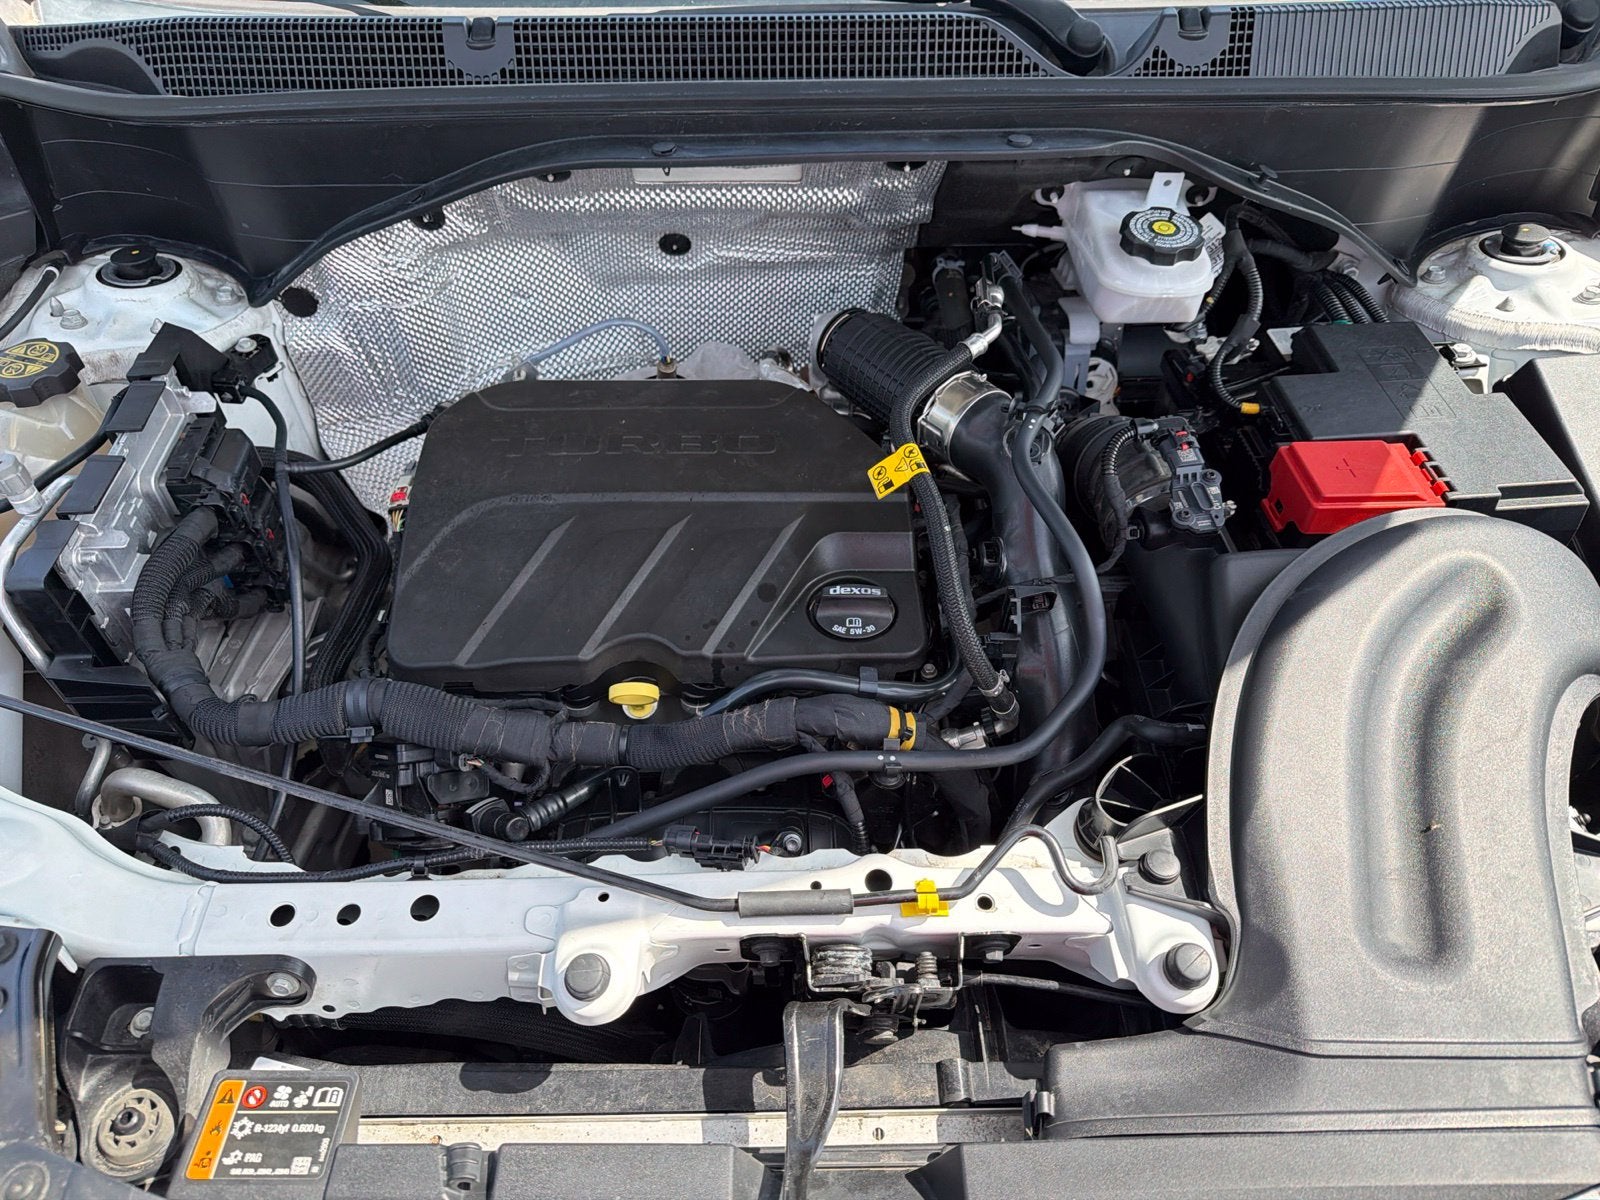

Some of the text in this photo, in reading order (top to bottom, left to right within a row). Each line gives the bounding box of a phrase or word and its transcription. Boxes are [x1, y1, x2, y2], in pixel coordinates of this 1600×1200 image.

[490, 433, 777, 457] TURBO
[829, 585, 881, 596] dexos
[832, 624, 876, 635] SAE 5W-30
[269, 1100, 290, 1108] AUTO
[314, 1123, 326, 1134] kg
[243, 1152, 263, 1163] PAG
